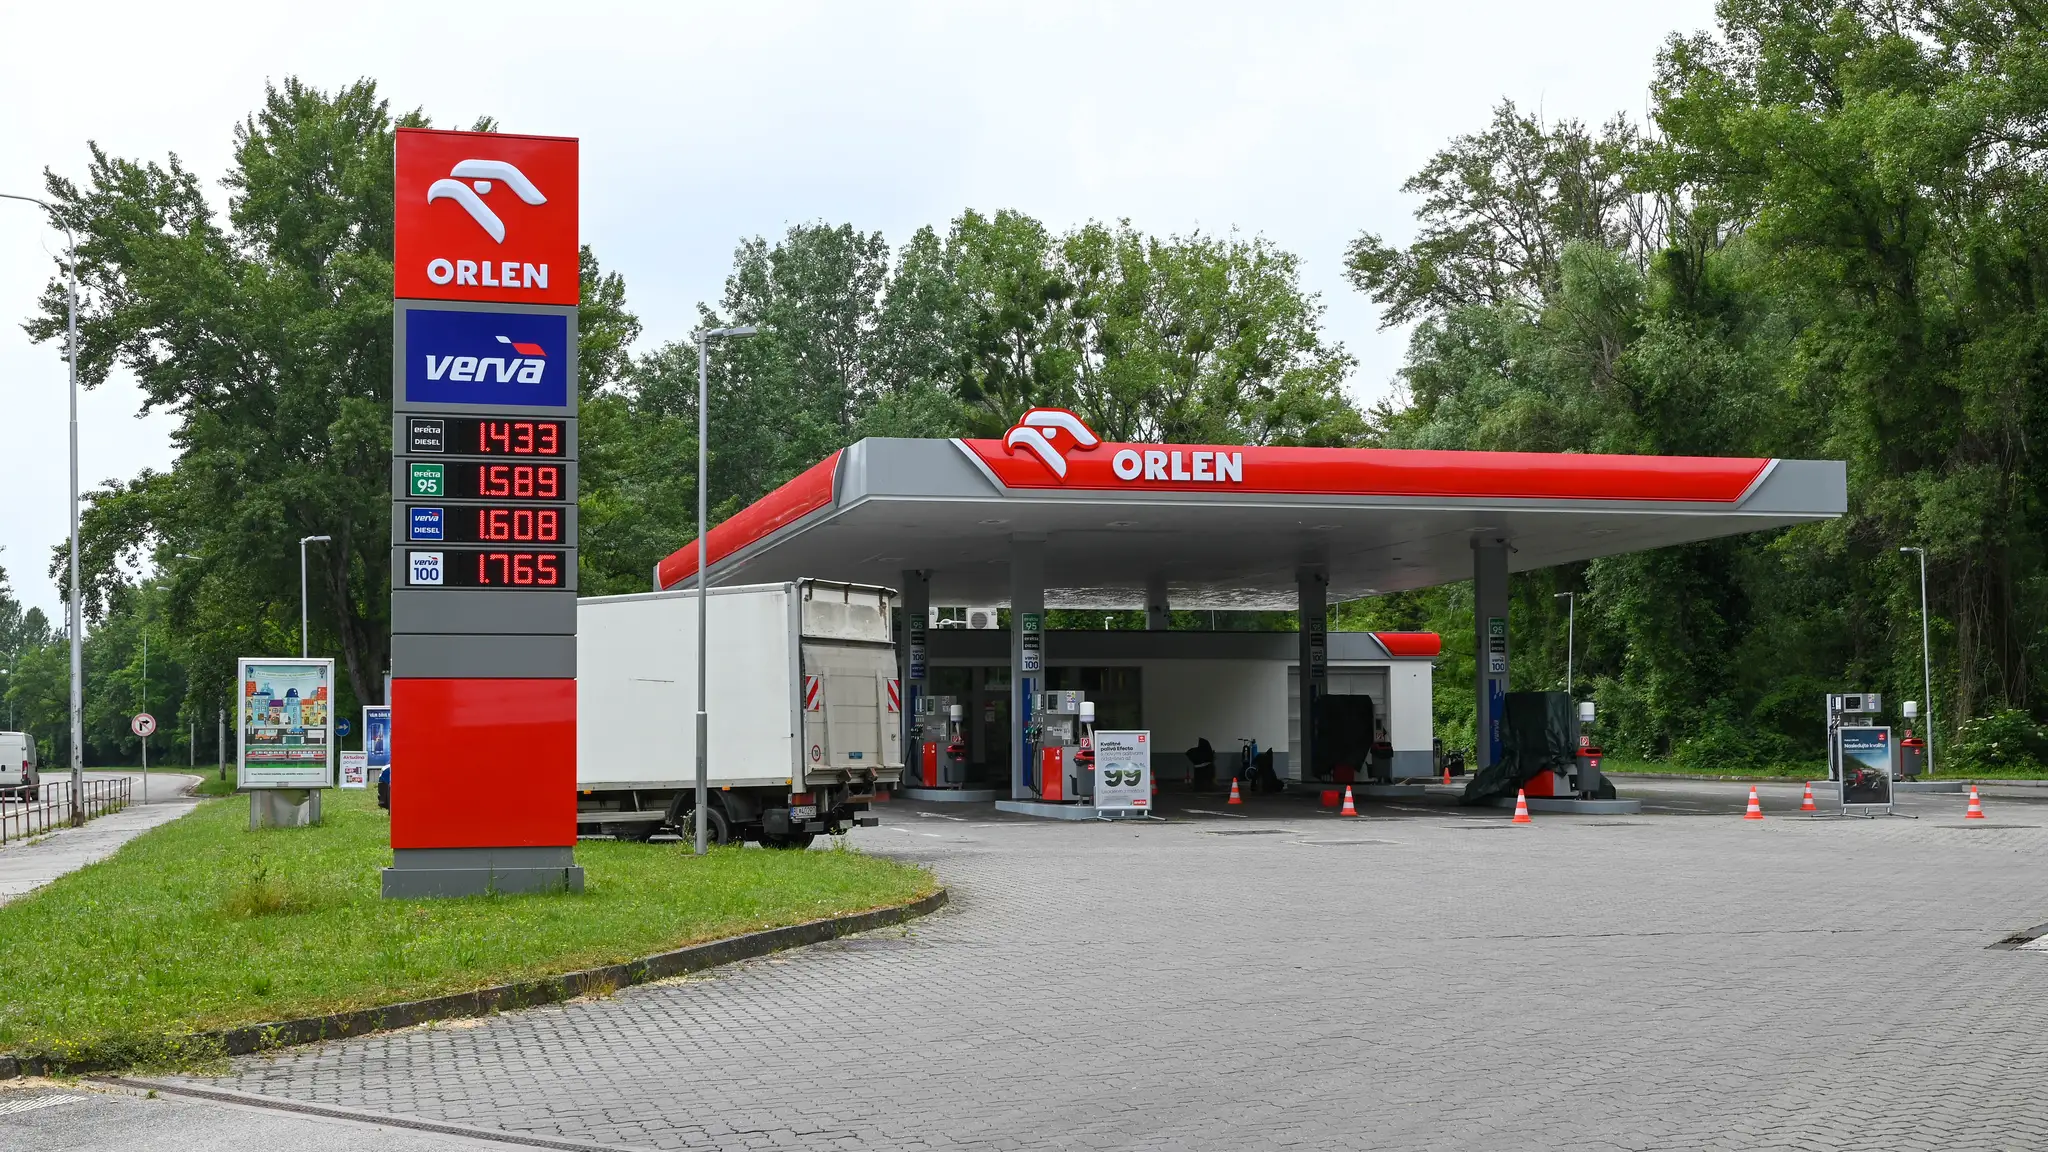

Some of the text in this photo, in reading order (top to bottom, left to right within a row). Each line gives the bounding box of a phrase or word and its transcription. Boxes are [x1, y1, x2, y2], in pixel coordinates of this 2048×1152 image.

[427, 258, 548, 288] ORLEN
[426, 355, 546, 384] verva
[414, 426, 441, 434] efecta
[414, 438, 440, 446] DIESEL
[480, 422, 557, 454] 1.433
[1112, 449, 1242, 482] ORLEN
[414, 470, 441, 478] efecta
[417, 479, 438, 493] 95
[480, 466, 557, 497] 1.589
[480, 510, 556, 541] 1.608
[414, 568, 439, 581] 100
[480, 554, 556, 585] 1.765
[1026, 622, 1037, 630] 95
[1493, 626, 1503, 634] 95
[1024, 661, 1039, 669] 100
